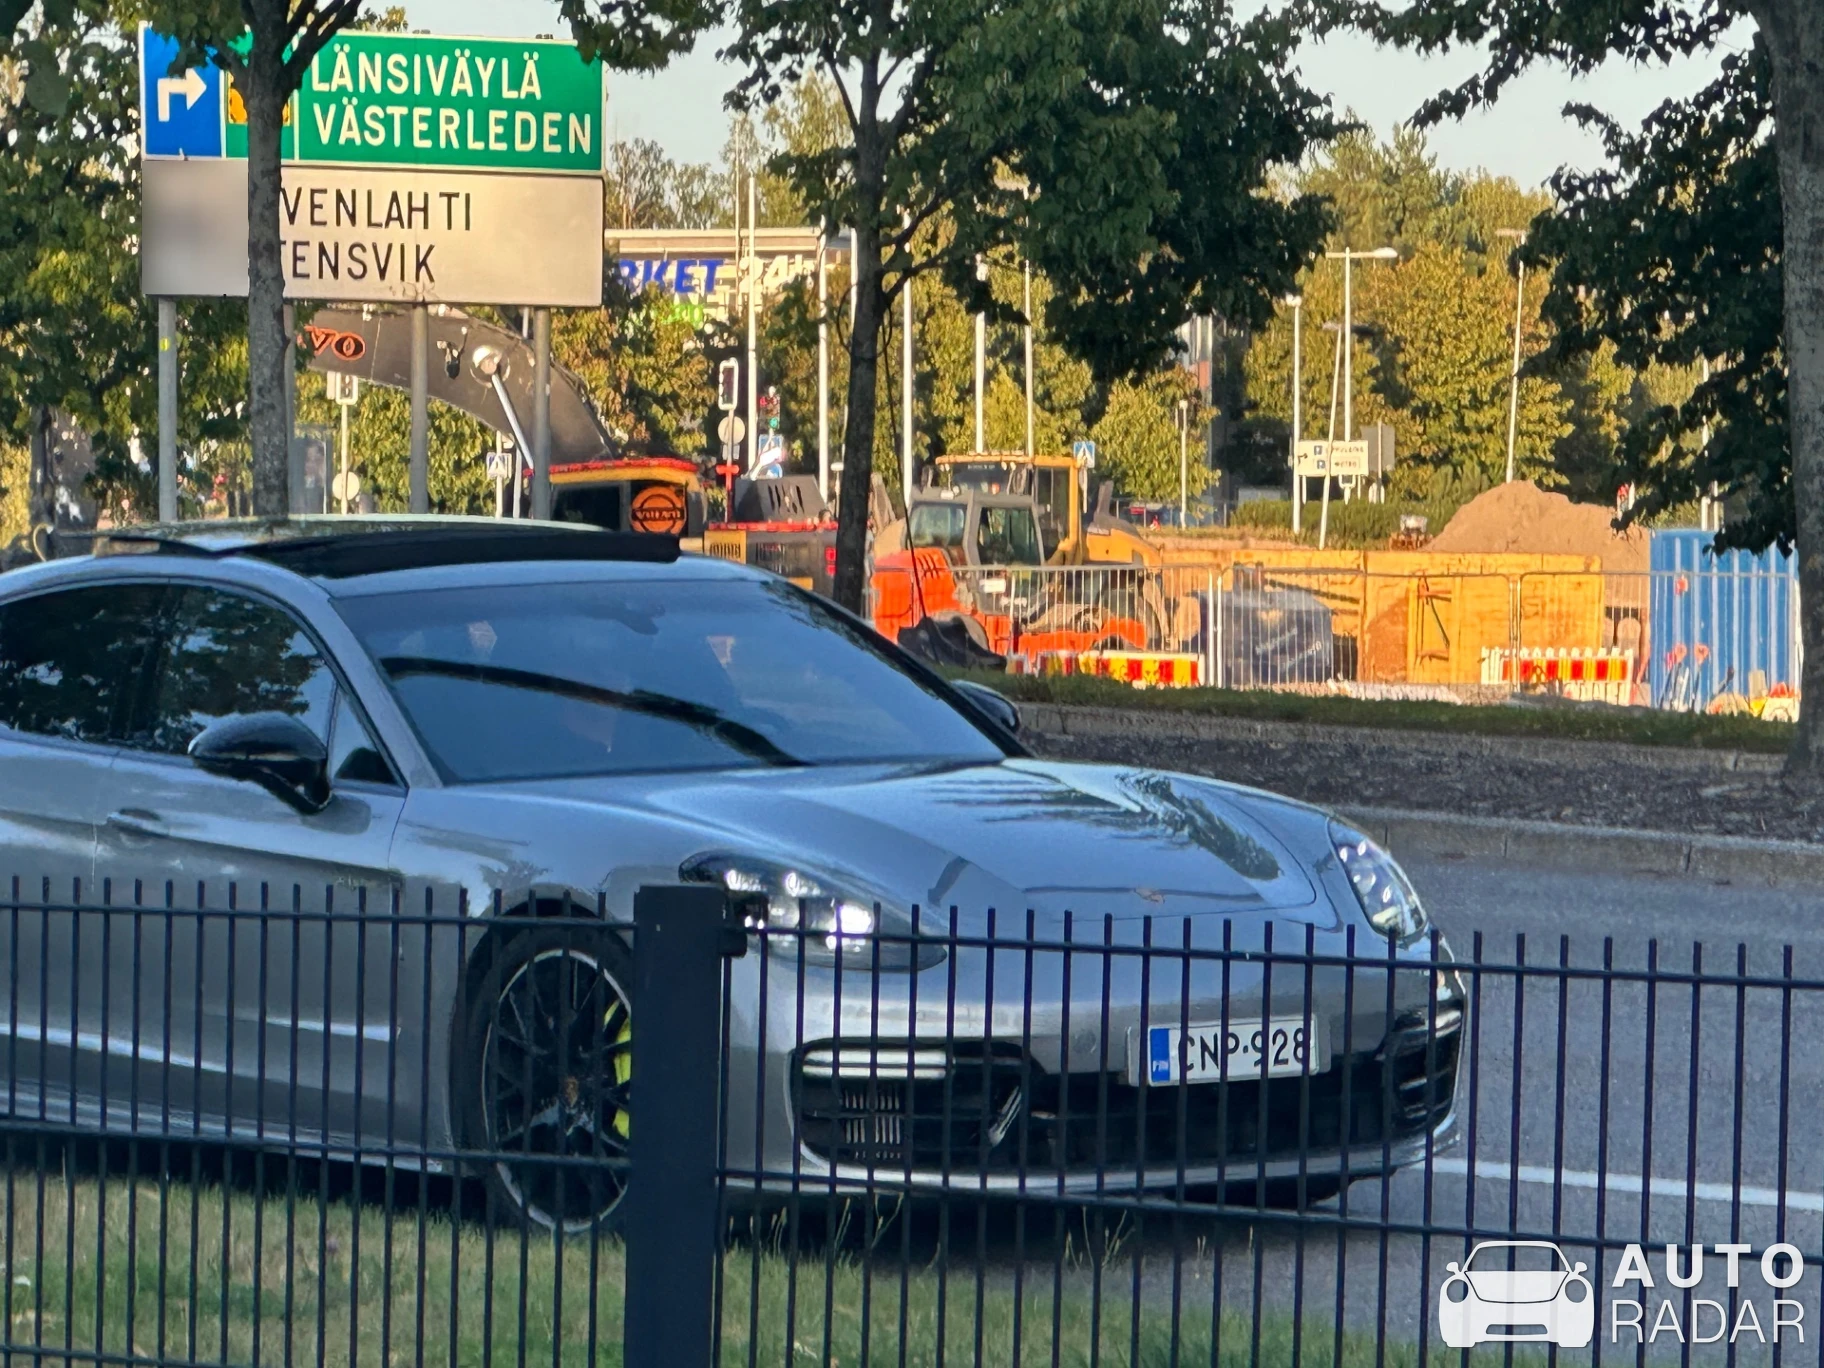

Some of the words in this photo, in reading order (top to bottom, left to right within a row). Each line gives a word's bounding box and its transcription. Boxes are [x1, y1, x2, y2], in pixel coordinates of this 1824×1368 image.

[311, 44, 542, 100] LÄNSIVÄYLÄ
[313, 97, 591, 155] VÄSTERLEDEN
[280, 187, 471, 231] VENLAHTI
[281, 240, 436, 283] ENSVIK
[618, 258, 724, 294] RKET
[302, 324, 366, 360] VO
